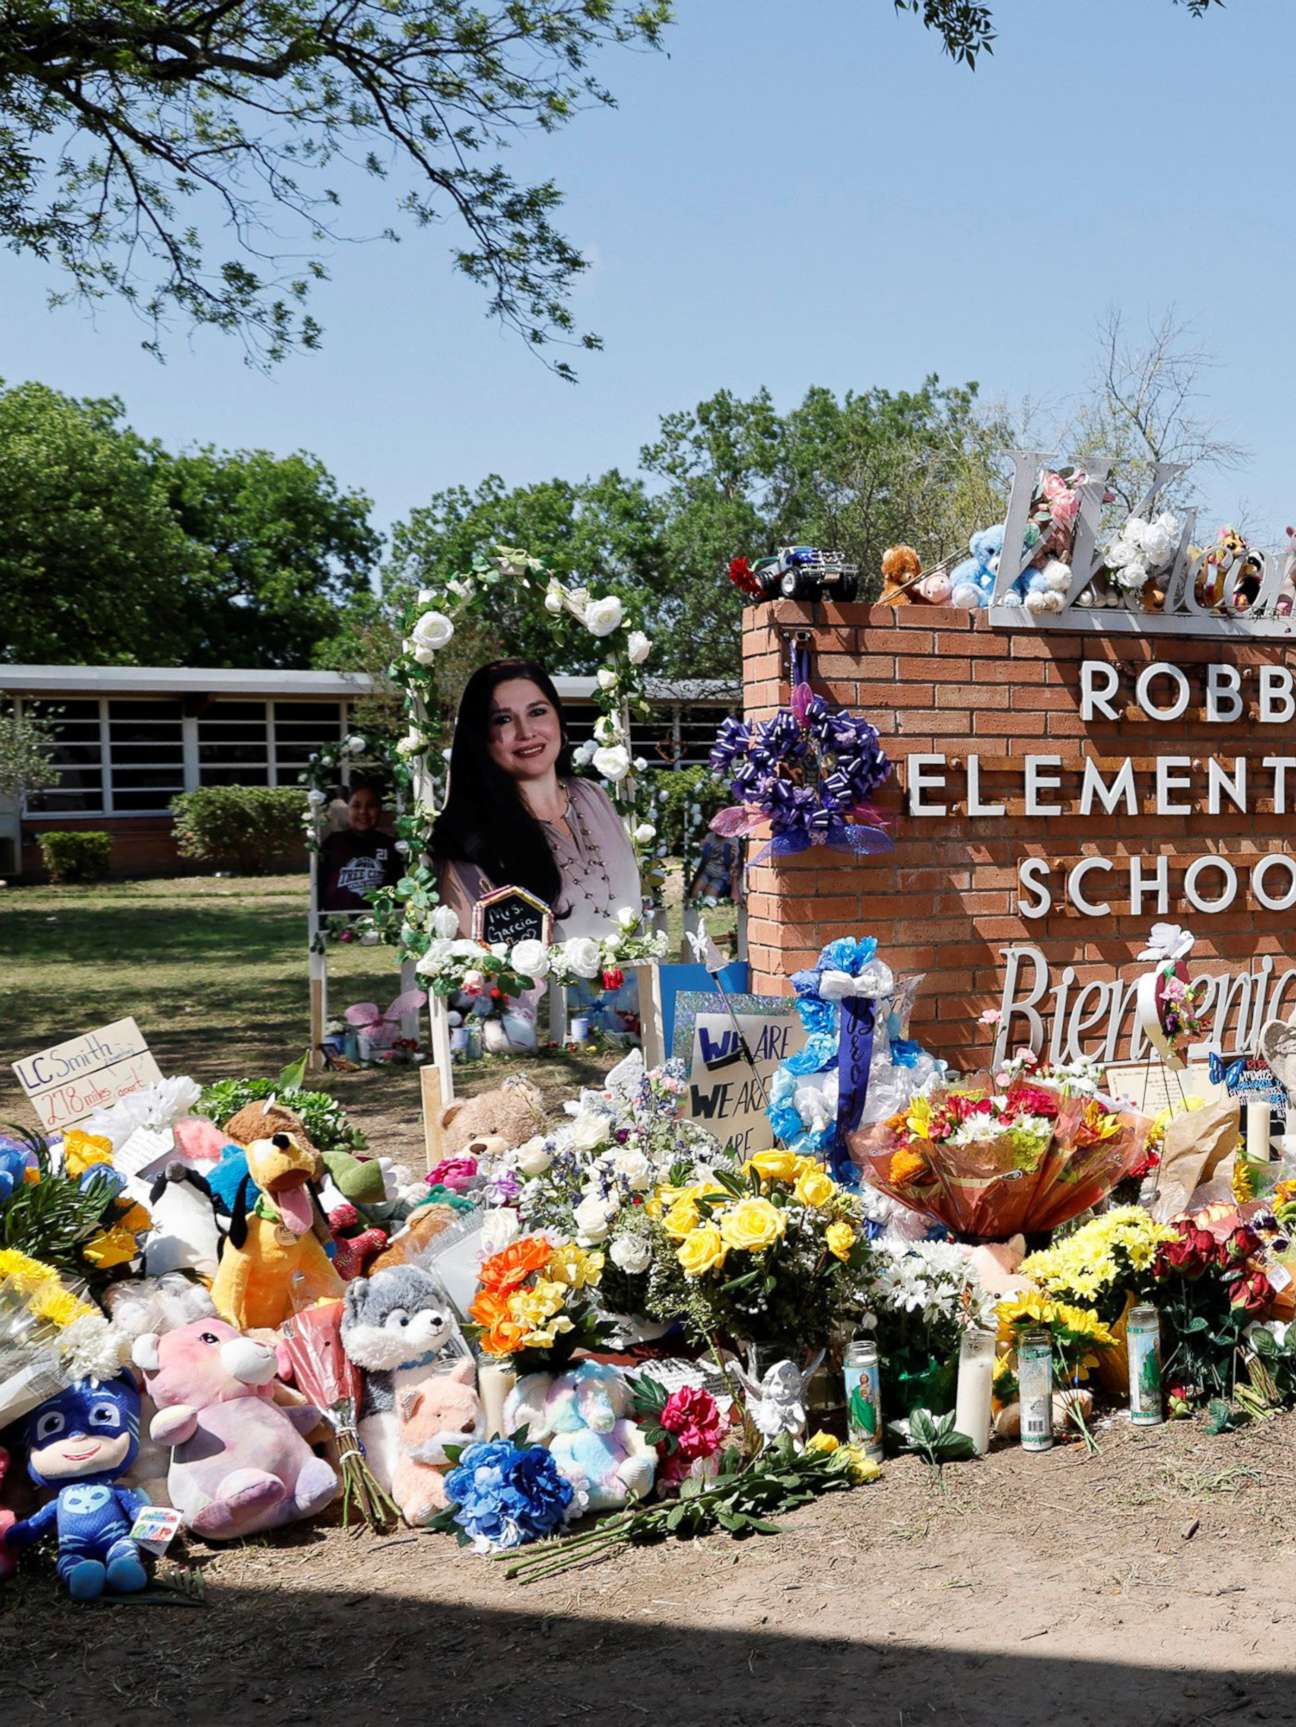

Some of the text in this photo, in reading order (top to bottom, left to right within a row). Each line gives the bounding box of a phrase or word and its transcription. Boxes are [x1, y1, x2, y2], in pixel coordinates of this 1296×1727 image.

[1079, 660, 1296, 724] ROBB
[375, 848, 388, 861] 21
[487, 917, 538, 943] Garcia
[488, 903, 524, 924] Mrs.
[16, 1056, 53, 1090] LC
[49, 1034, 113, 1078] Smith
[753, 1024, 793, 1060] ARE
[41, 1086, 85, 1126] 278
[84, 1079, 112, 1106] miles
[690, 1074, 773, 1119] WE ARE
